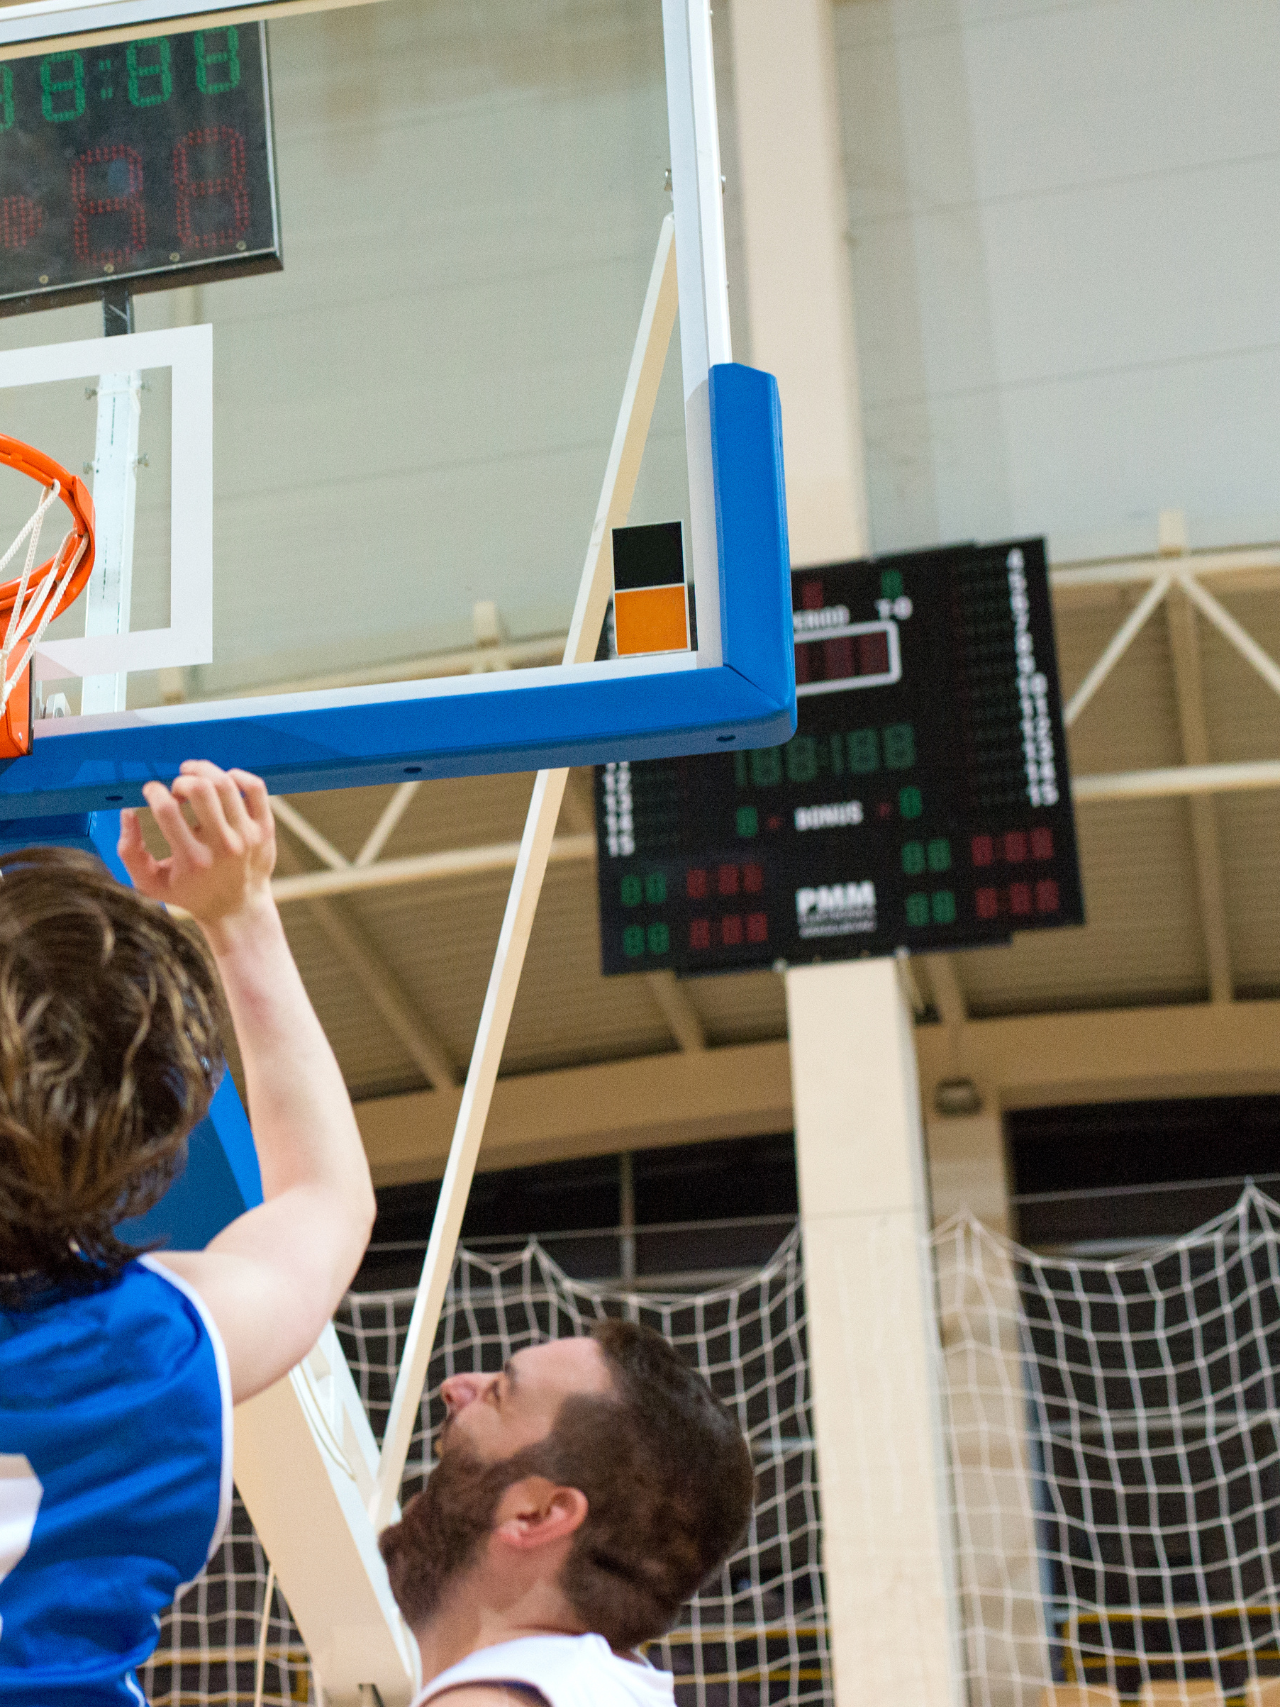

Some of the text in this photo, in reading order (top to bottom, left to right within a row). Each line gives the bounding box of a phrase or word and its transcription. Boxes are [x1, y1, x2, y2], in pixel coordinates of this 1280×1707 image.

[792, 605, 851, 634] ERIOD
[794, 800, 864, 832] BONUS
[795, 880, 877, 920] PMM
